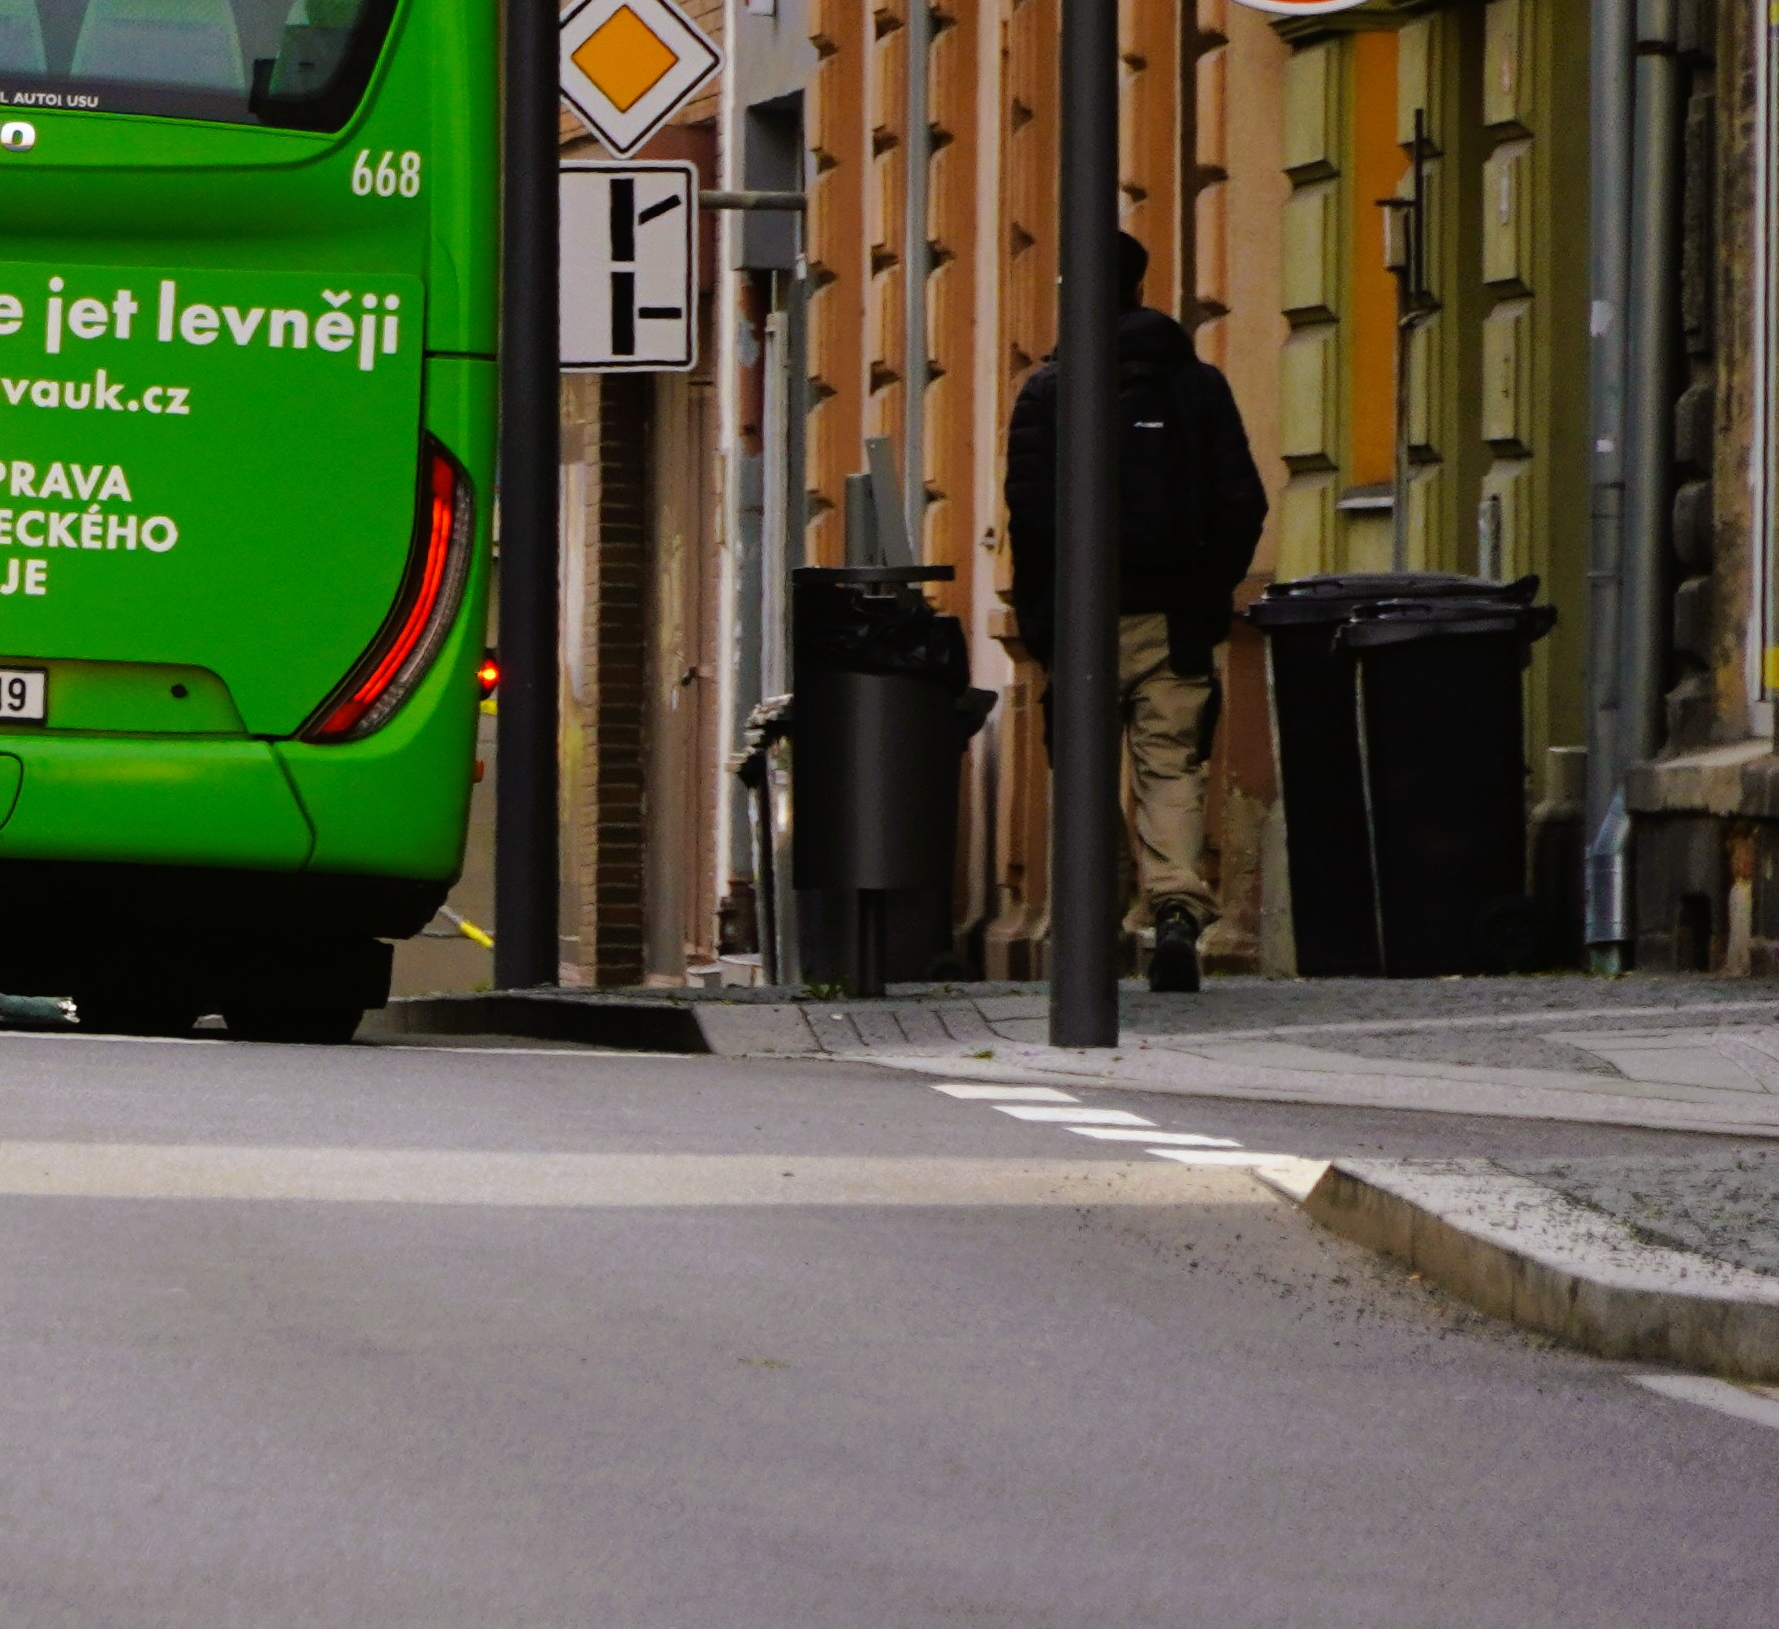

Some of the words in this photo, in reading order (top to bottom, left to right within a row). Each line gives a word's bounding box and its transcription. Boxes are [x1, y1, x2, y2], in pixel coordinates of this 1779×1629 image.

[352, 149, 421, 198] 668
[45, 276, 139, 354] jet
[157, 279, 400, 371] levněji
